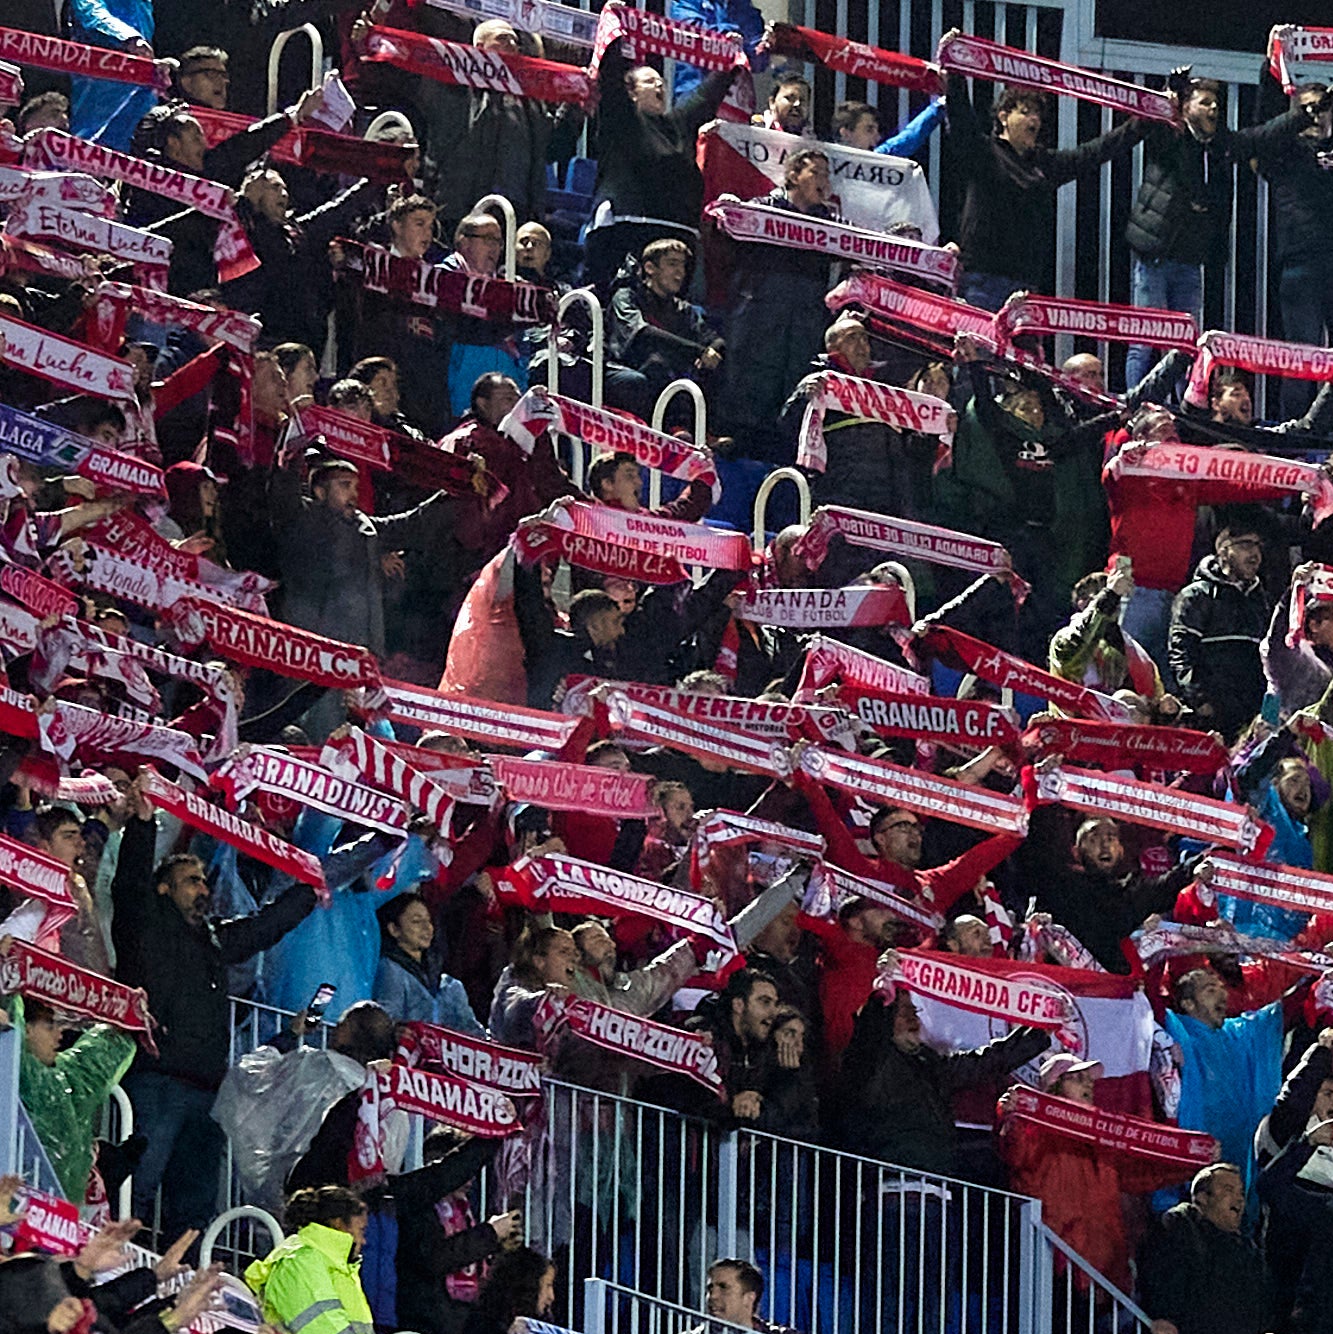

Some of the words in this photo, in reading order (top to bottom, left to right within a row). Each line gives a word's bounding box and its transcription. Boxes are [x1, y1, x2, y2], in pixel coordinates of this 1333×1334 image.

[52, 135, 184, 191] GRANADA
[40, 205, 100, 247] Eterna
[108, 223, 168, 261] Lucha
[34, 344, 99, 384] Lucha
[88, 452, 161, 489] GRANADA
[626, 518, 686, 539] GRANADA
[561, 532, 640, 572] GRANADA
[780, 608, 798, 622] DE
[200, 610, 323, 678] GRANADA
[858, 697, 958, 735] GRANADA
[964, 708, 1005, 738] C.F.
[579, 782, 596, 802] de
[185, 790, 265, 848] GRANADA
[554, 860, 587, 886] LA
[588, 871, 728, 932] HORIZONTAL
[916, 967, 1010, 1005] GRANADA
[589, 1007, 725, 1087] HORIZONTAL
